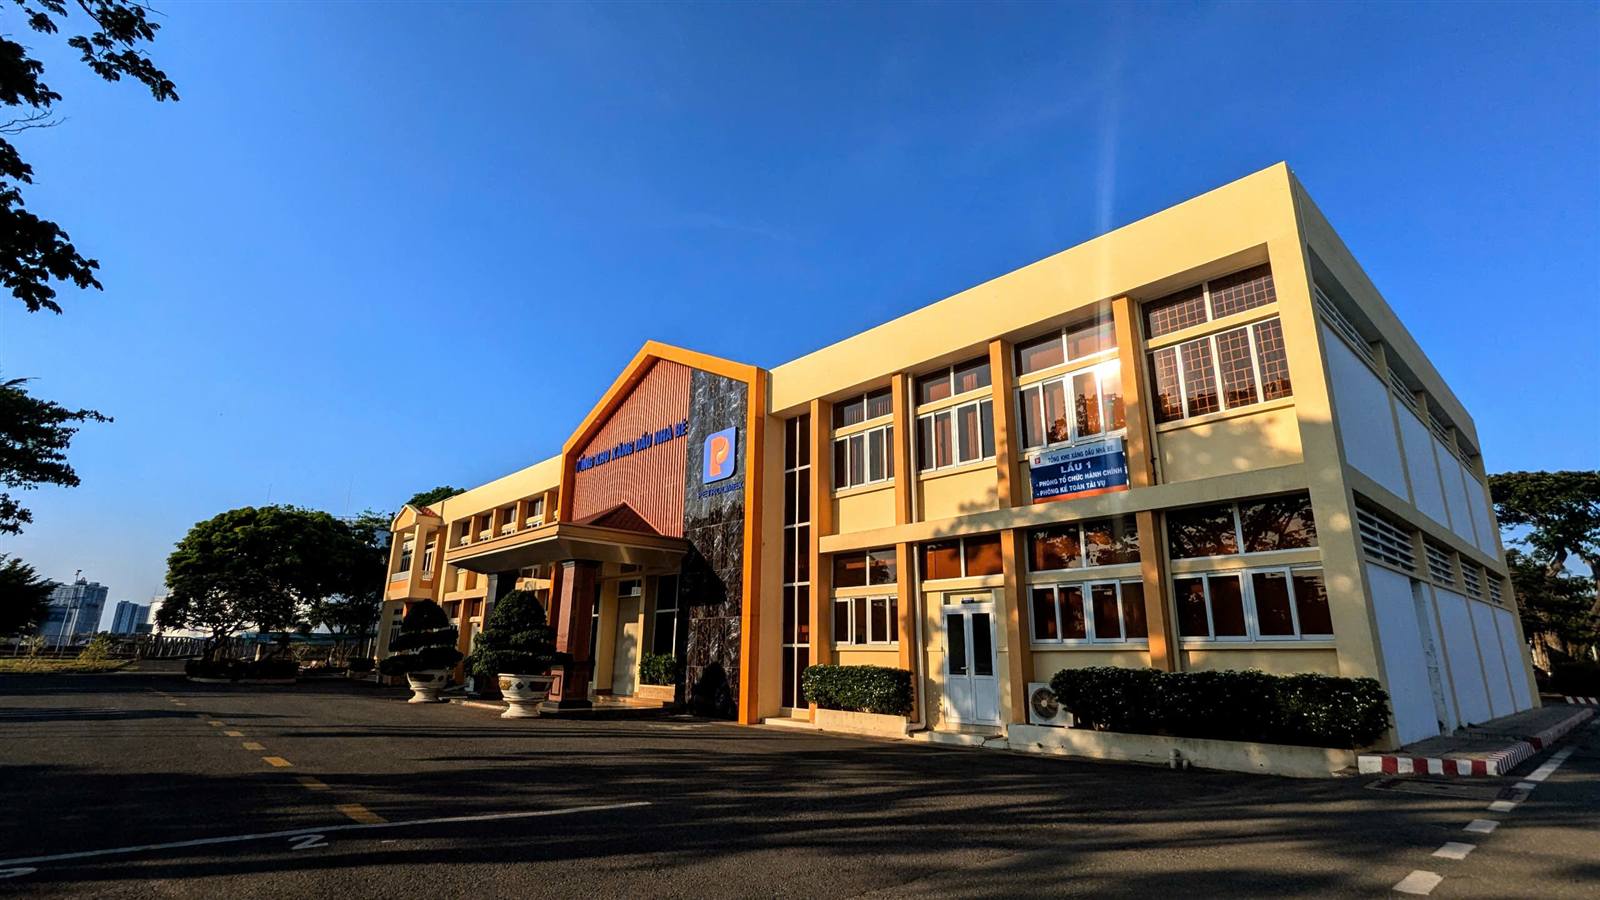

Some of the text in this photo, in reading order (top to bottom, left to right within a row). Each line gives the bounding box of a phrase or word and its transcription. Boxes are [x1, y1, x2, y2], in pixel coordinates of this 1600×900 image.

[1085, 460, 1092, 469] 1
[1039, 478, 1058, 488] PHÒNG
[1084, 470, 1102, 480] HÀNH
[1102, 467, 1123, 477] CHÍNH
[1040, 488, 1059, 497] PHÒNG
